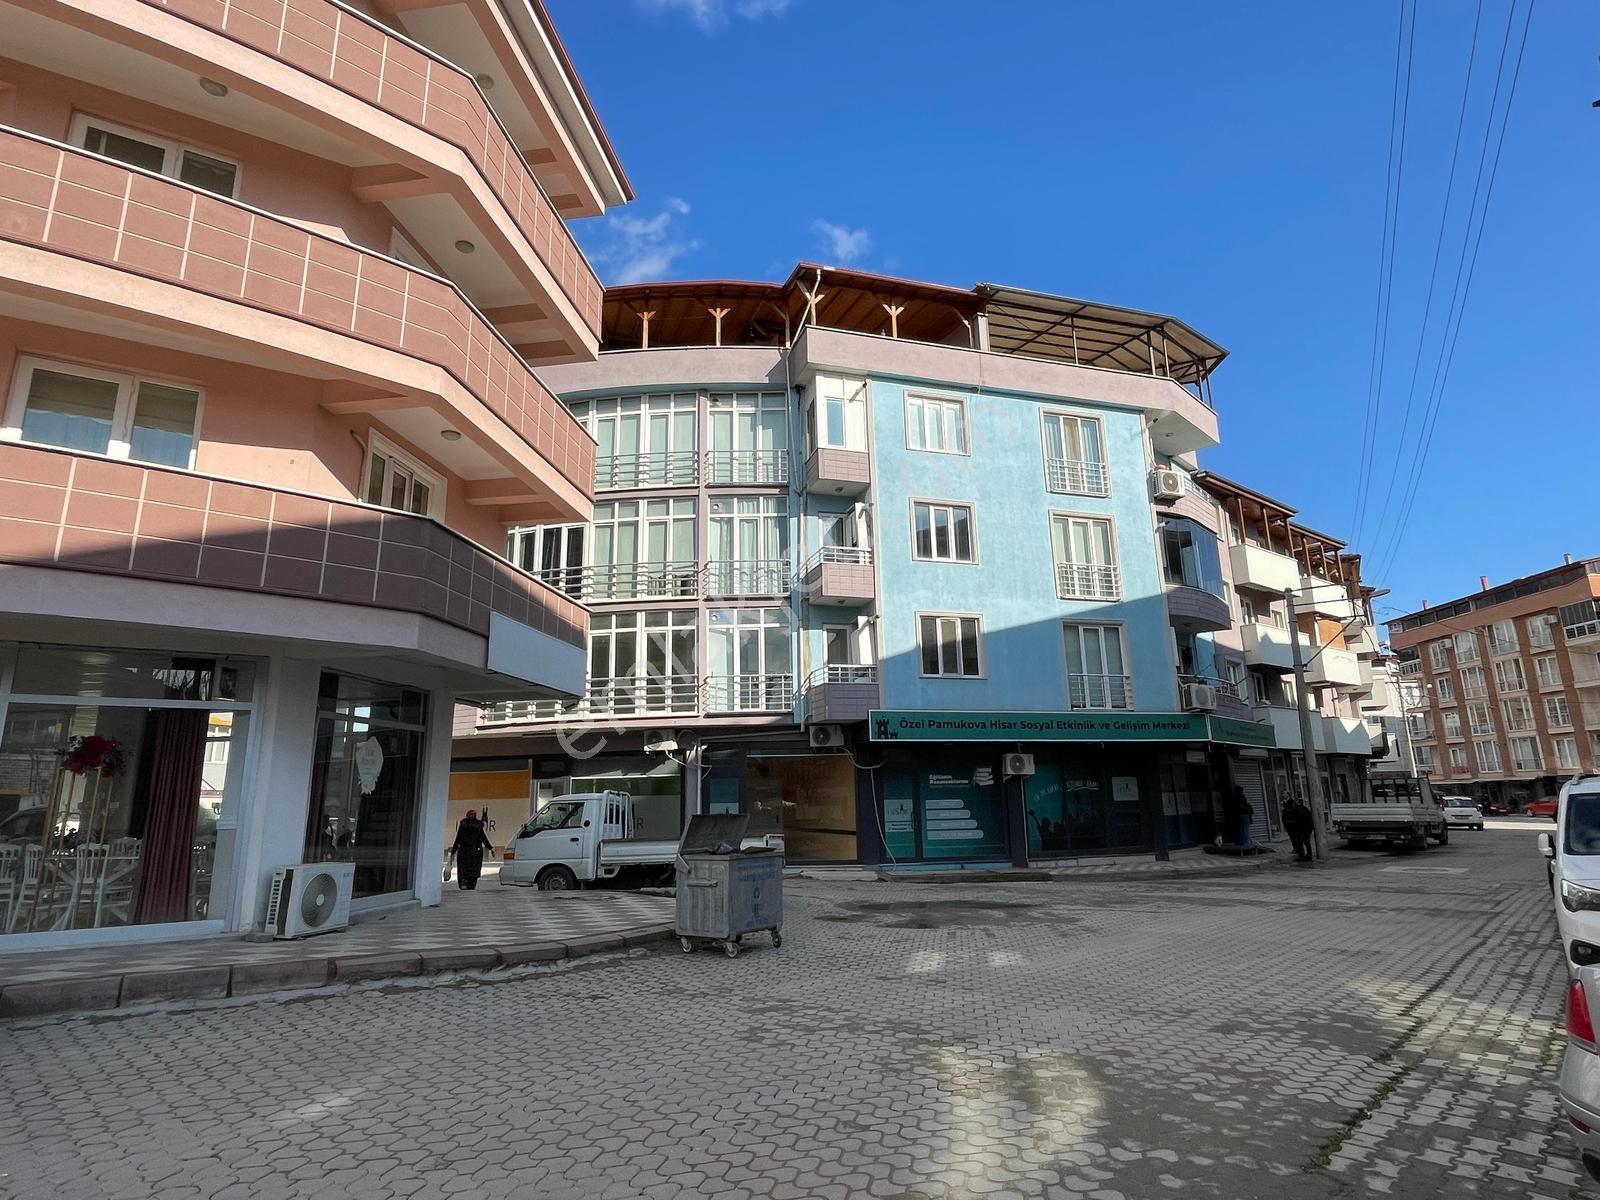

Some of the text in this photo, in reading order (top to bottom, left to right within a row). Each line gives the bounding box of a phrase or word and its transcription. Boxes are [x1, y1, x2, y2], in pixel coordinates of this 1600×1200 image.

[899, 717, 1191, 732] Özel Pamukova Hisar Sosyal Etkinlik ve Gelişim Merkezi
